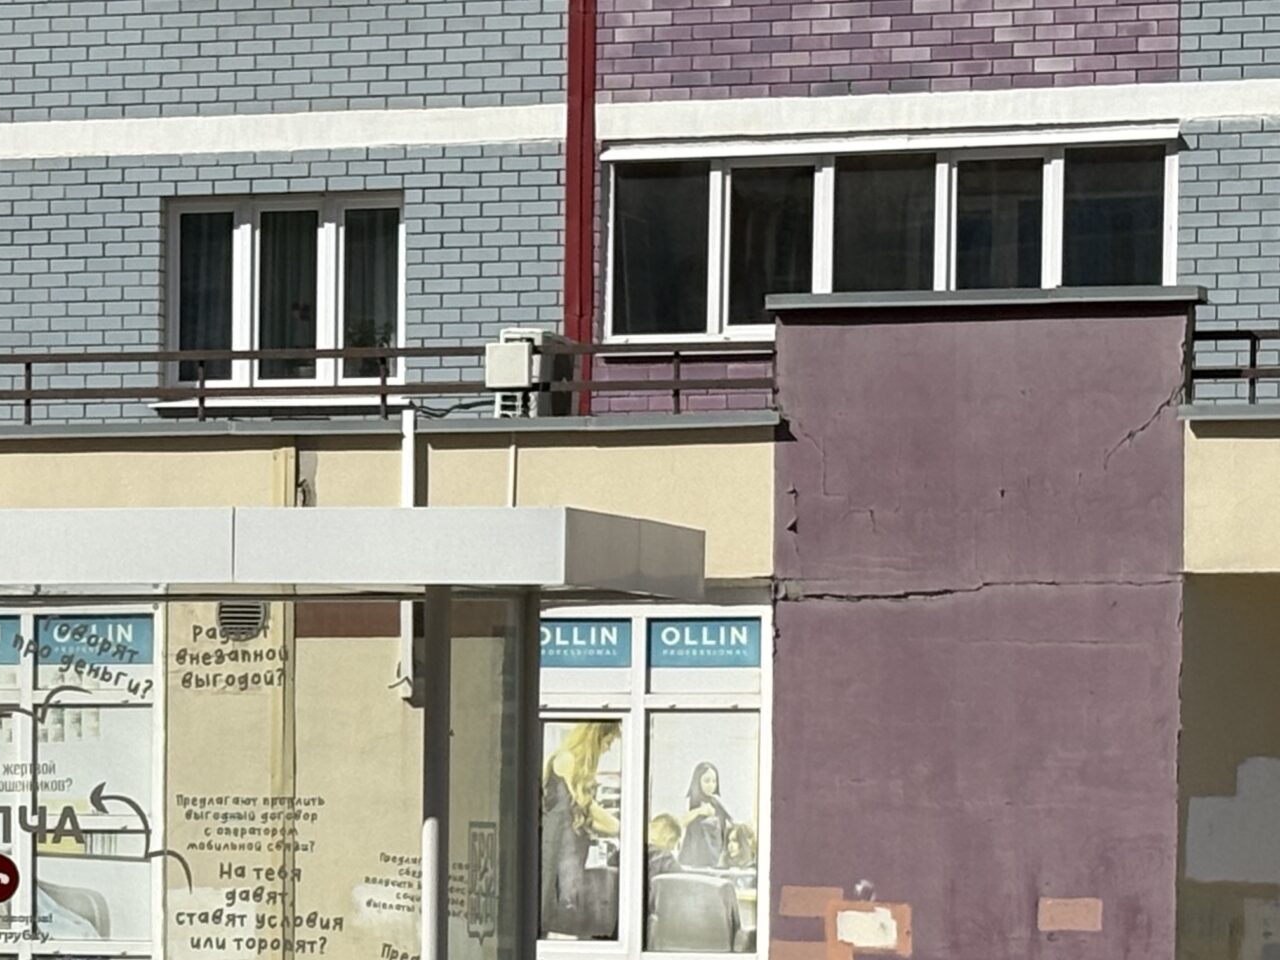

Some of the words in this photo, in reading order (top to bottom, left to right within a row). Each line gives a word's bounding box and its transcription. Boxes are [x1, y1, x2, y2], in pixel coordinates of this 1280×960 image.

[661, 626, 748, 646] OLLIN
[176, 645, 289, 666] внезапной
[12, 634, 53, 658] про
[58, 653, 154, 700] деньги?
[181, 667, 286, 691] выгодой?
[176, 794, 258, 809] Предлагают
[185, 809, 255, 823] выгодный
[261, 809, 318, 823] договор
[216, 826, 299, 838] оператором
[186, 839, 262, 851] мобильной
[219, 862, 246, 880] На
[253, 864, 302, 882] тебя
[175, 908, 247, 928] ставят
[256, 911, 344, 931] условия
[190, 937, 226, 950] или
[233, 936, 328, 955] торопят?
